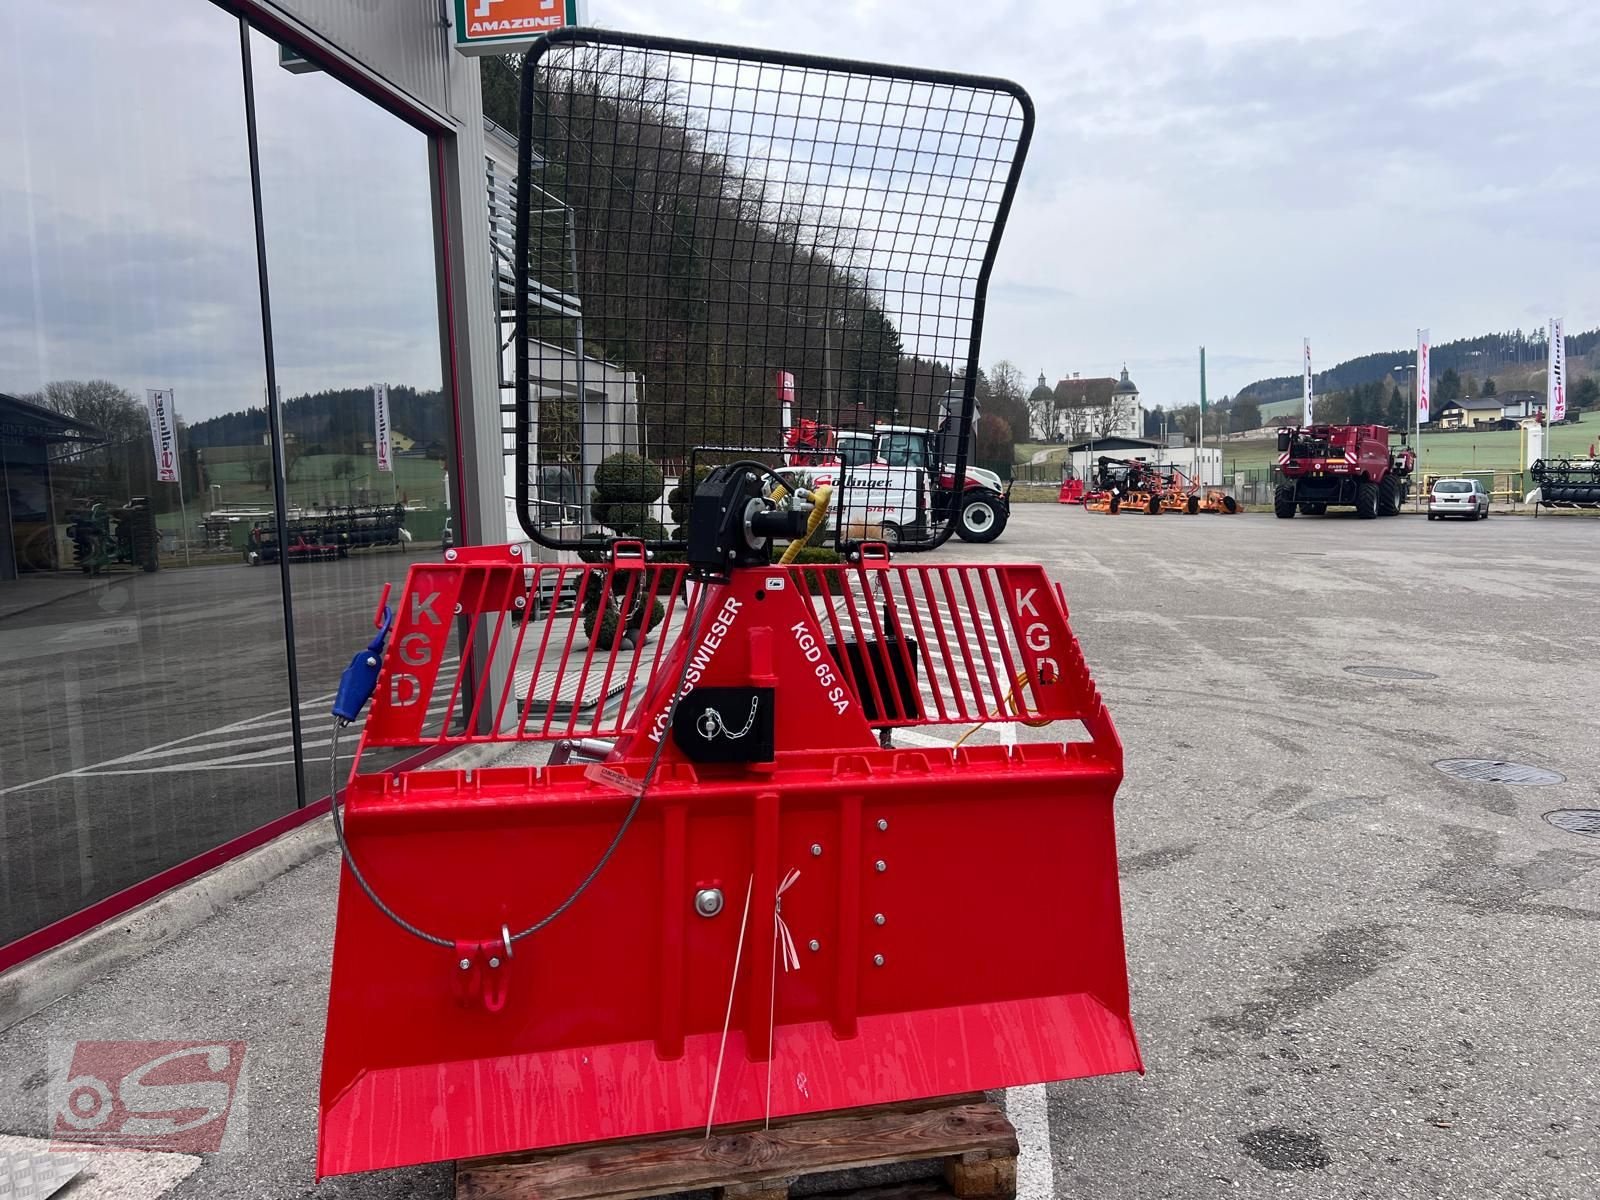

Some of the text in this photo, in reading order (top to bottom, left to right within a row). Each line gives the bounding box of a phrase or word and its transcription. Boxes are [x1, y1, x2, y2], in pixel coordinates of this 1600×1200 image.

[470, 15, 562, 33] AMAZONE
[647, 596, 743, 743] KÖGSWIESER
[790, 621, 851, 716] KGD 65 SA
